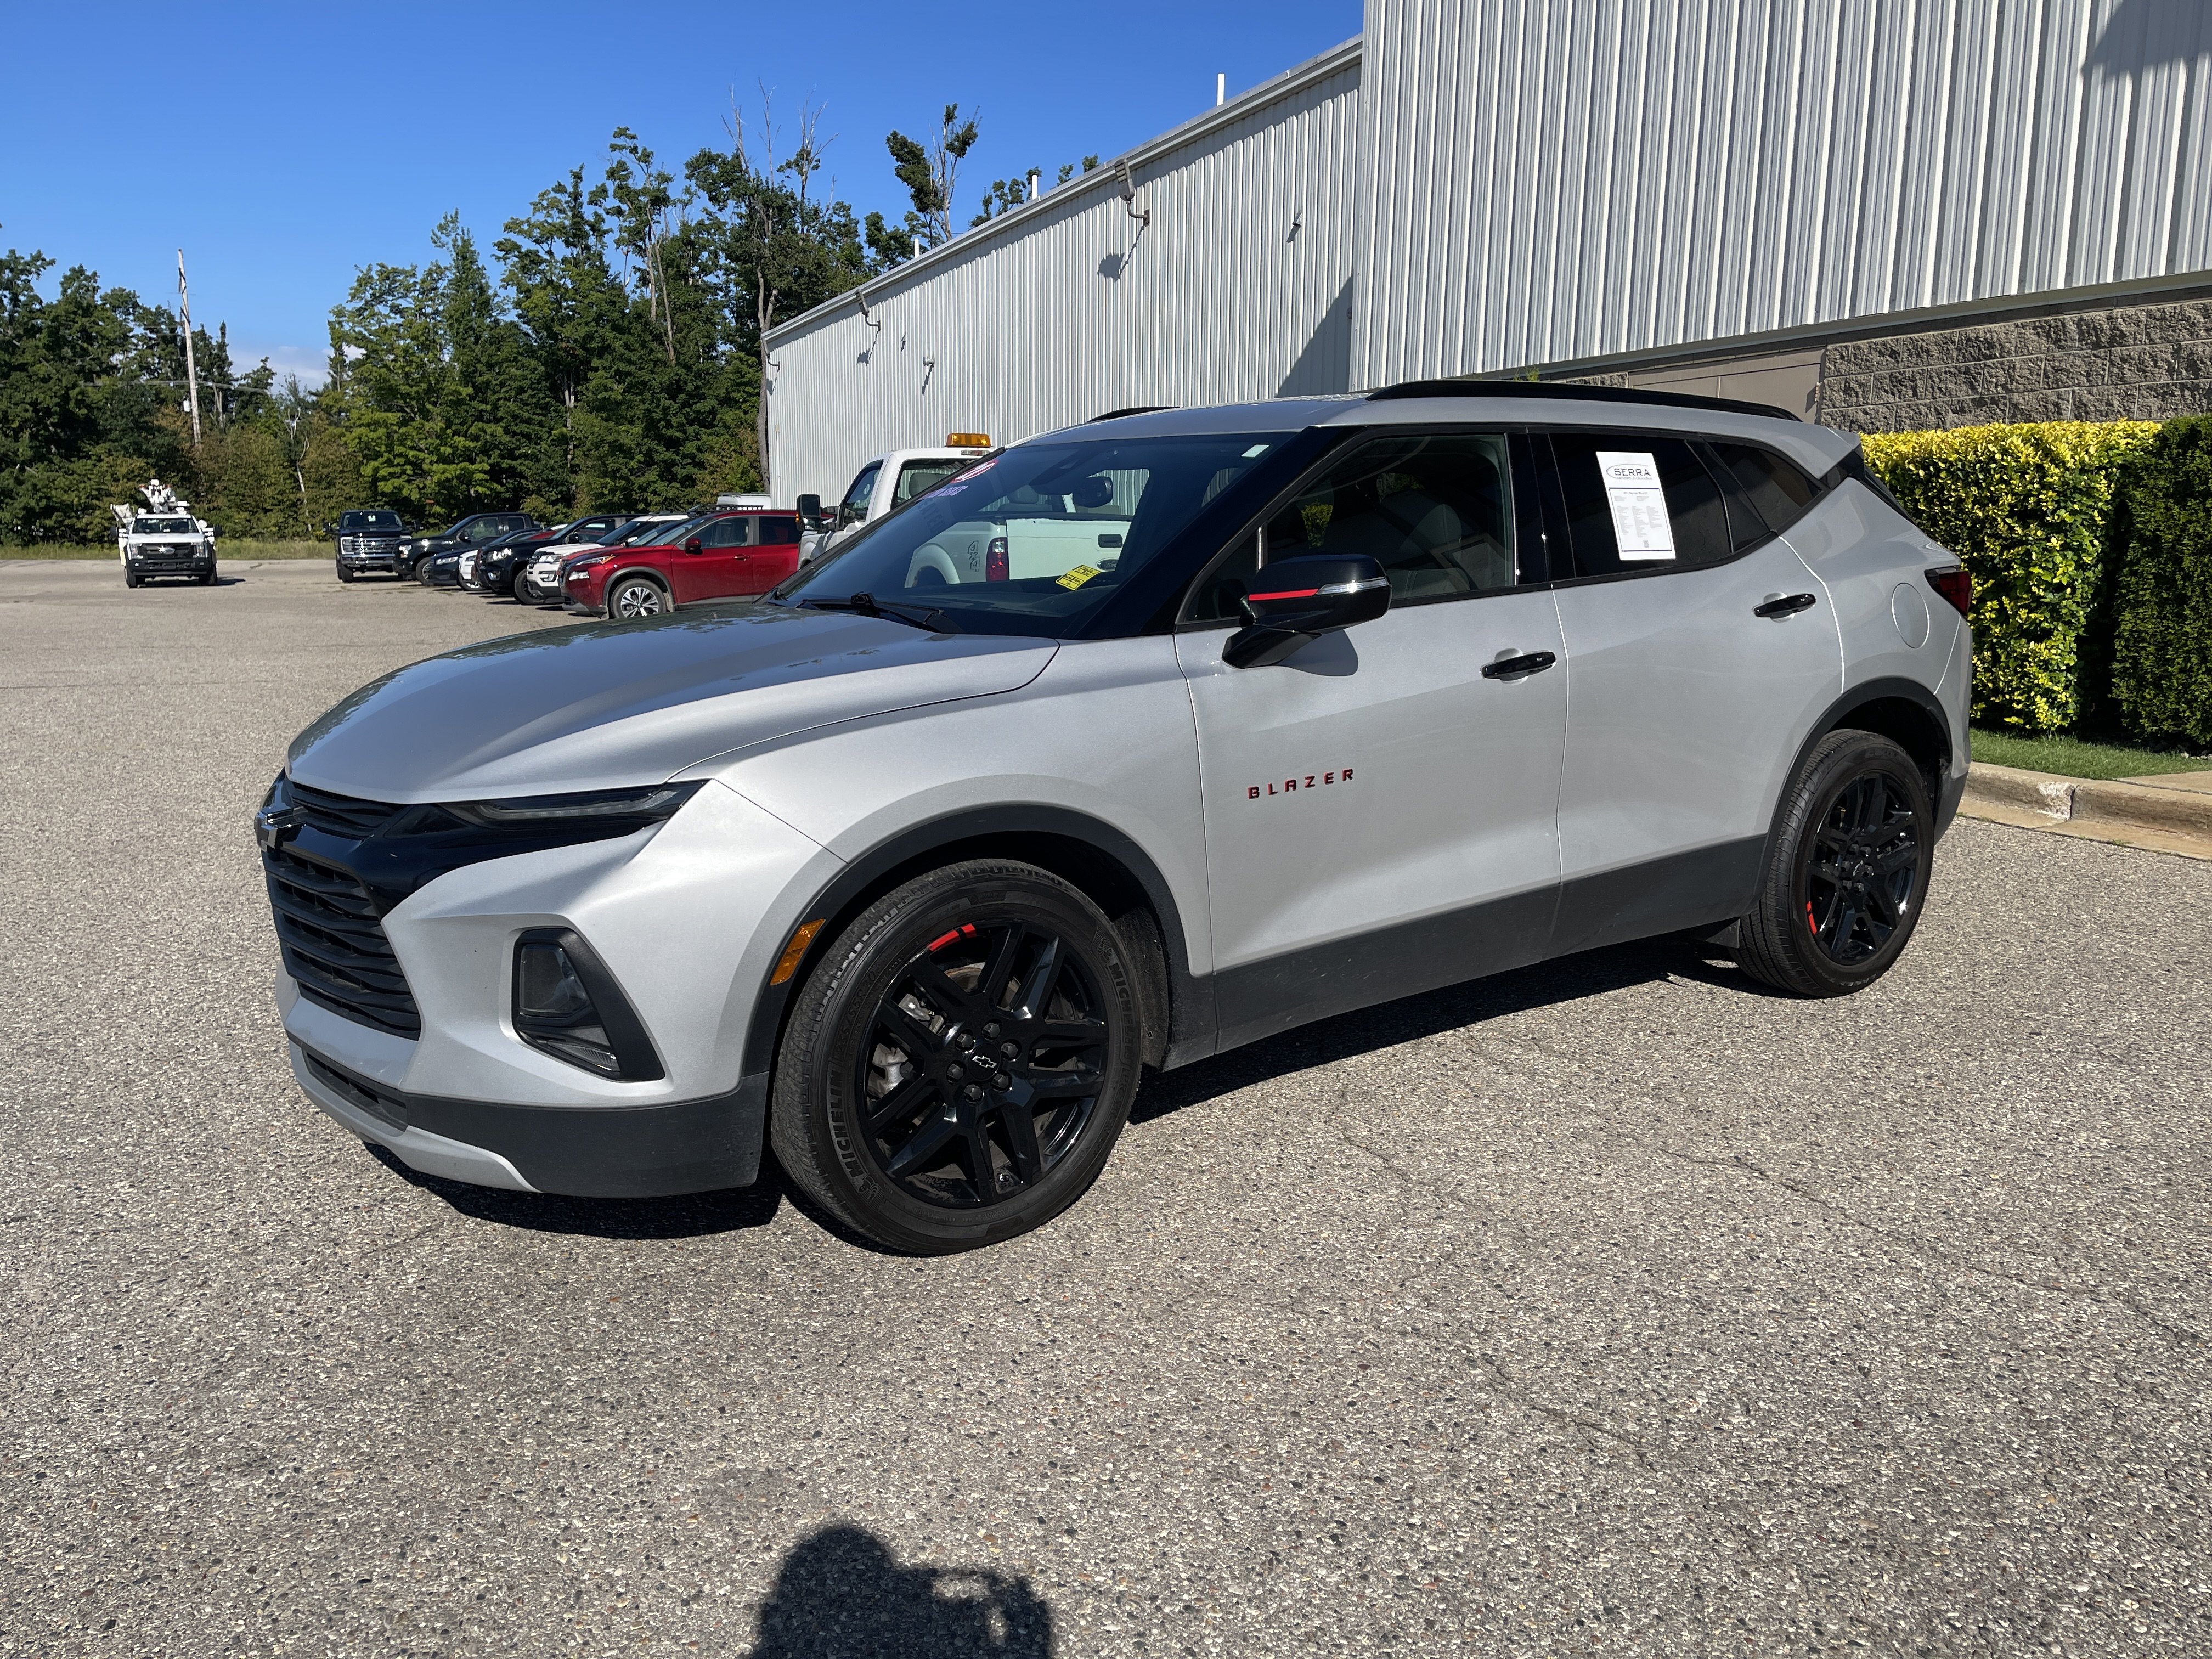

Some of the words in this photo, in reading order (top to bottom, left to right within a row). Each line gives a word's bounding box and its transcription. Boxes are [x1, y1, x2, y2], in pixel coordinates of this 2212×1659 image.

[1614, 468, 1651, 476] SERRA
[1248, 768, 1354, 800] BLAZER
[1109, 963, 1136, 1059] MICHELIN
[830, 1070, 864, 1178] MICHELIN
